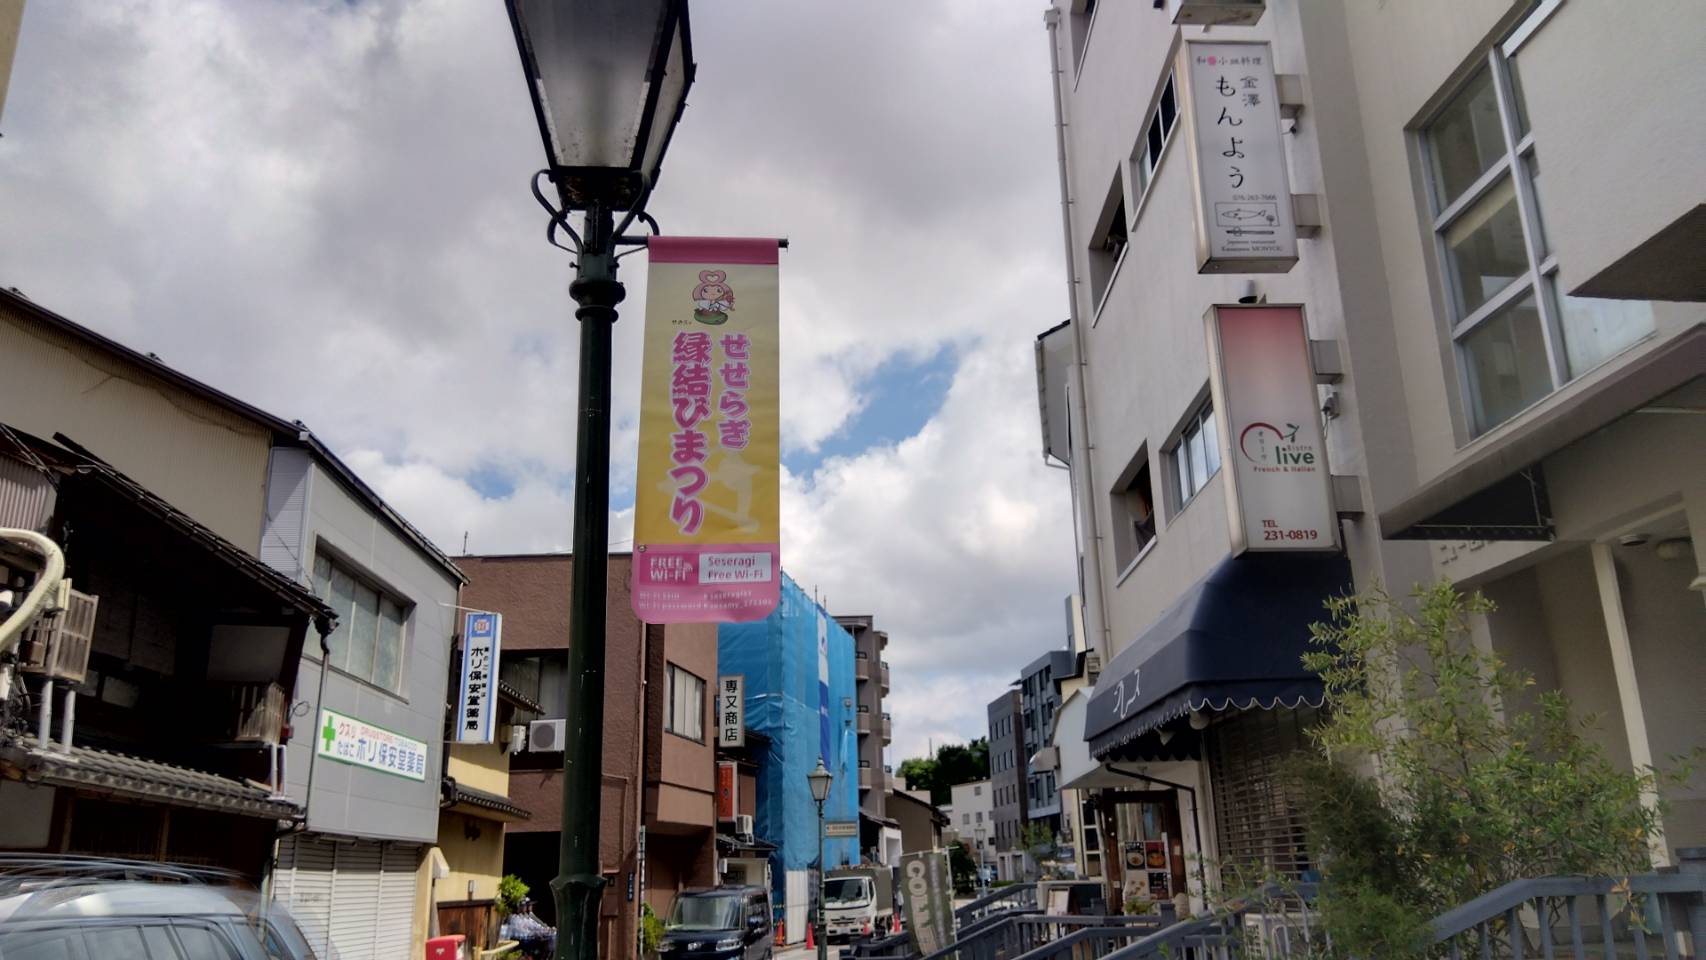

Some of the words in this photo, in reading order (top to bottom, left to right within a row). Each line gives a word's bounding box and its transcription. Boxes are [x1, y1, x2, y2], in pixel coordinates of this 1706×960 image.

[1216, 75, 1245, 188] もんよう
[719, 333, 751, 449] せせらぎ
[671, 332, 711, 534] 縁結びまつり
[1262, 519, 1278, 528] TEL
[1264, 529, 1317, 541] 231-0819
[650, 556, 682, 568] FREE
[708, 555, 755, 568] Seseragi
[650, 568, 686, 581] Wi-Fi
[708, 570, 732, 579] Free
[735, 569, 763, 579] Wi-Fi
[465, 647, 483, 730] ホリ保安堂薬局
